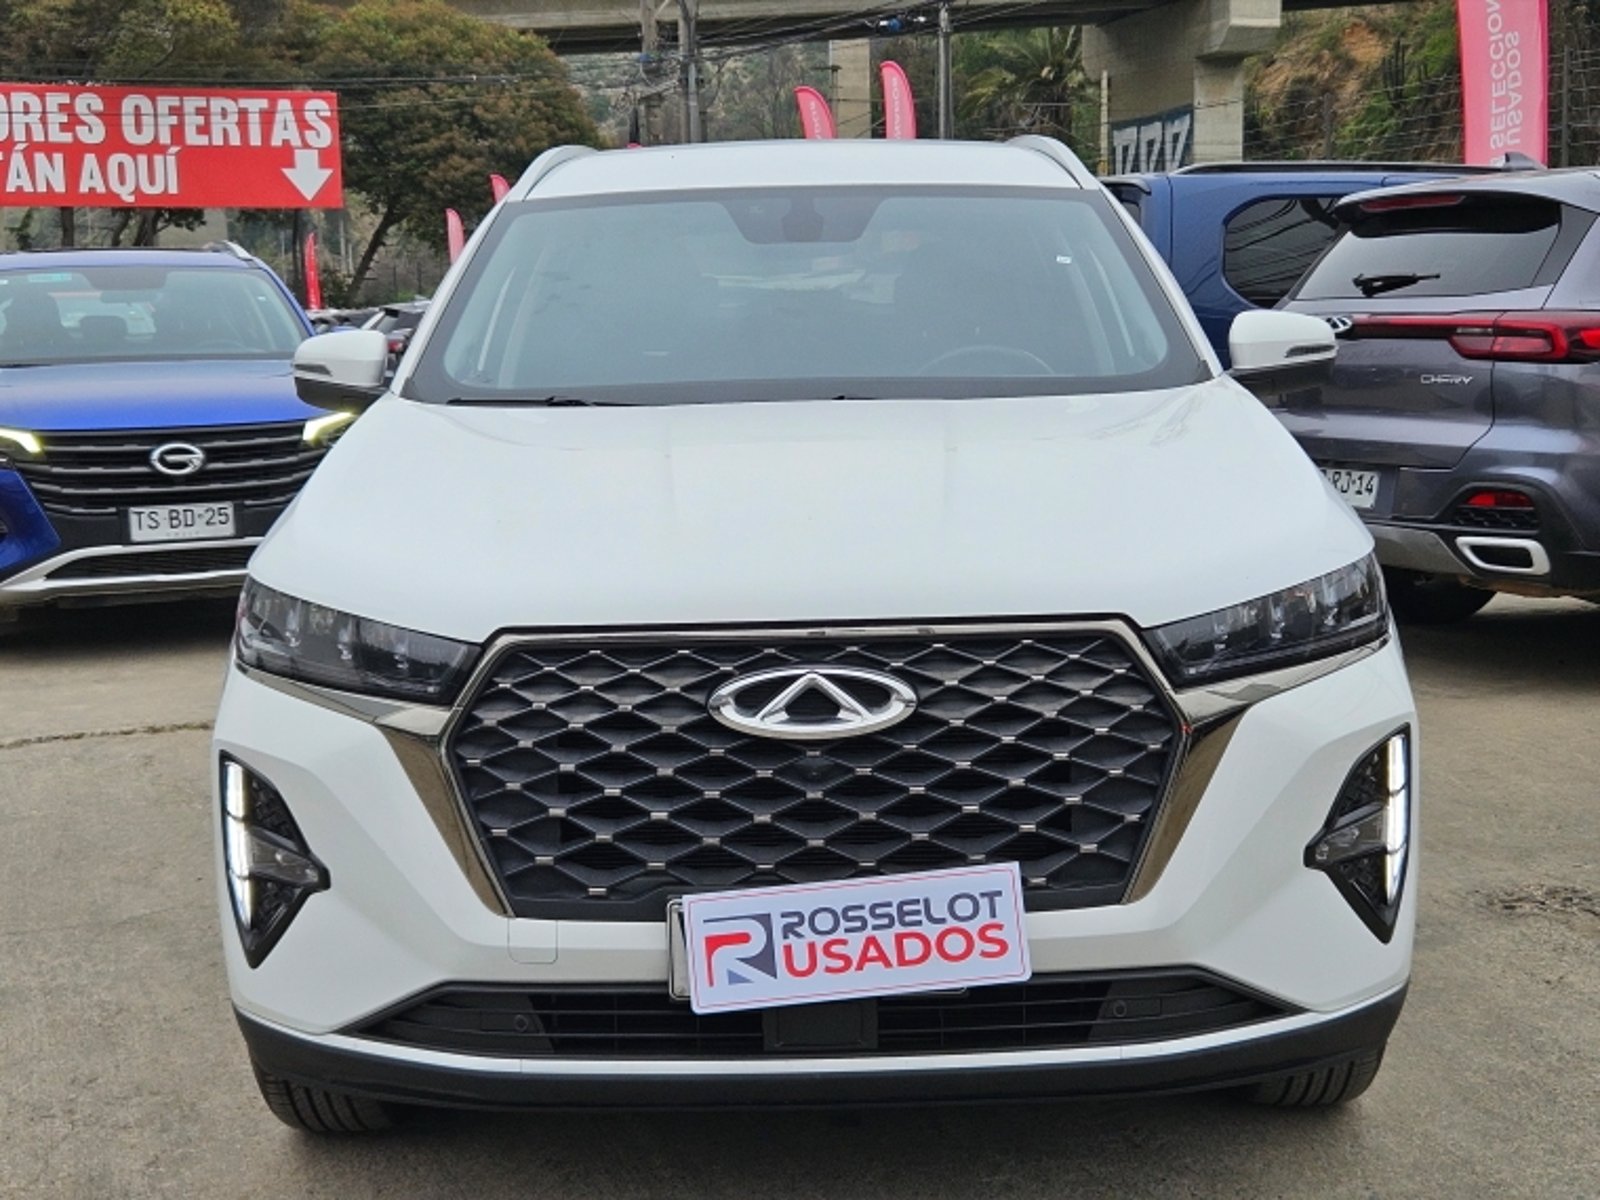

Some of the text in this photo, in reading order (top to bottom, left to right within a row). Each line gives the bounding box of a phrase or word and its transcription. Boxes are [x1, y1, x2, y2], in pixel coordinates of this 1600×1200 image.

[121, 94, 333, 148] OFERTAS
[0, 142, 182, 203] ÁN AQUÍ
[781, 890, 1003, 940] ROSSELOT
[783, 923, 1009, 978] USADOS
